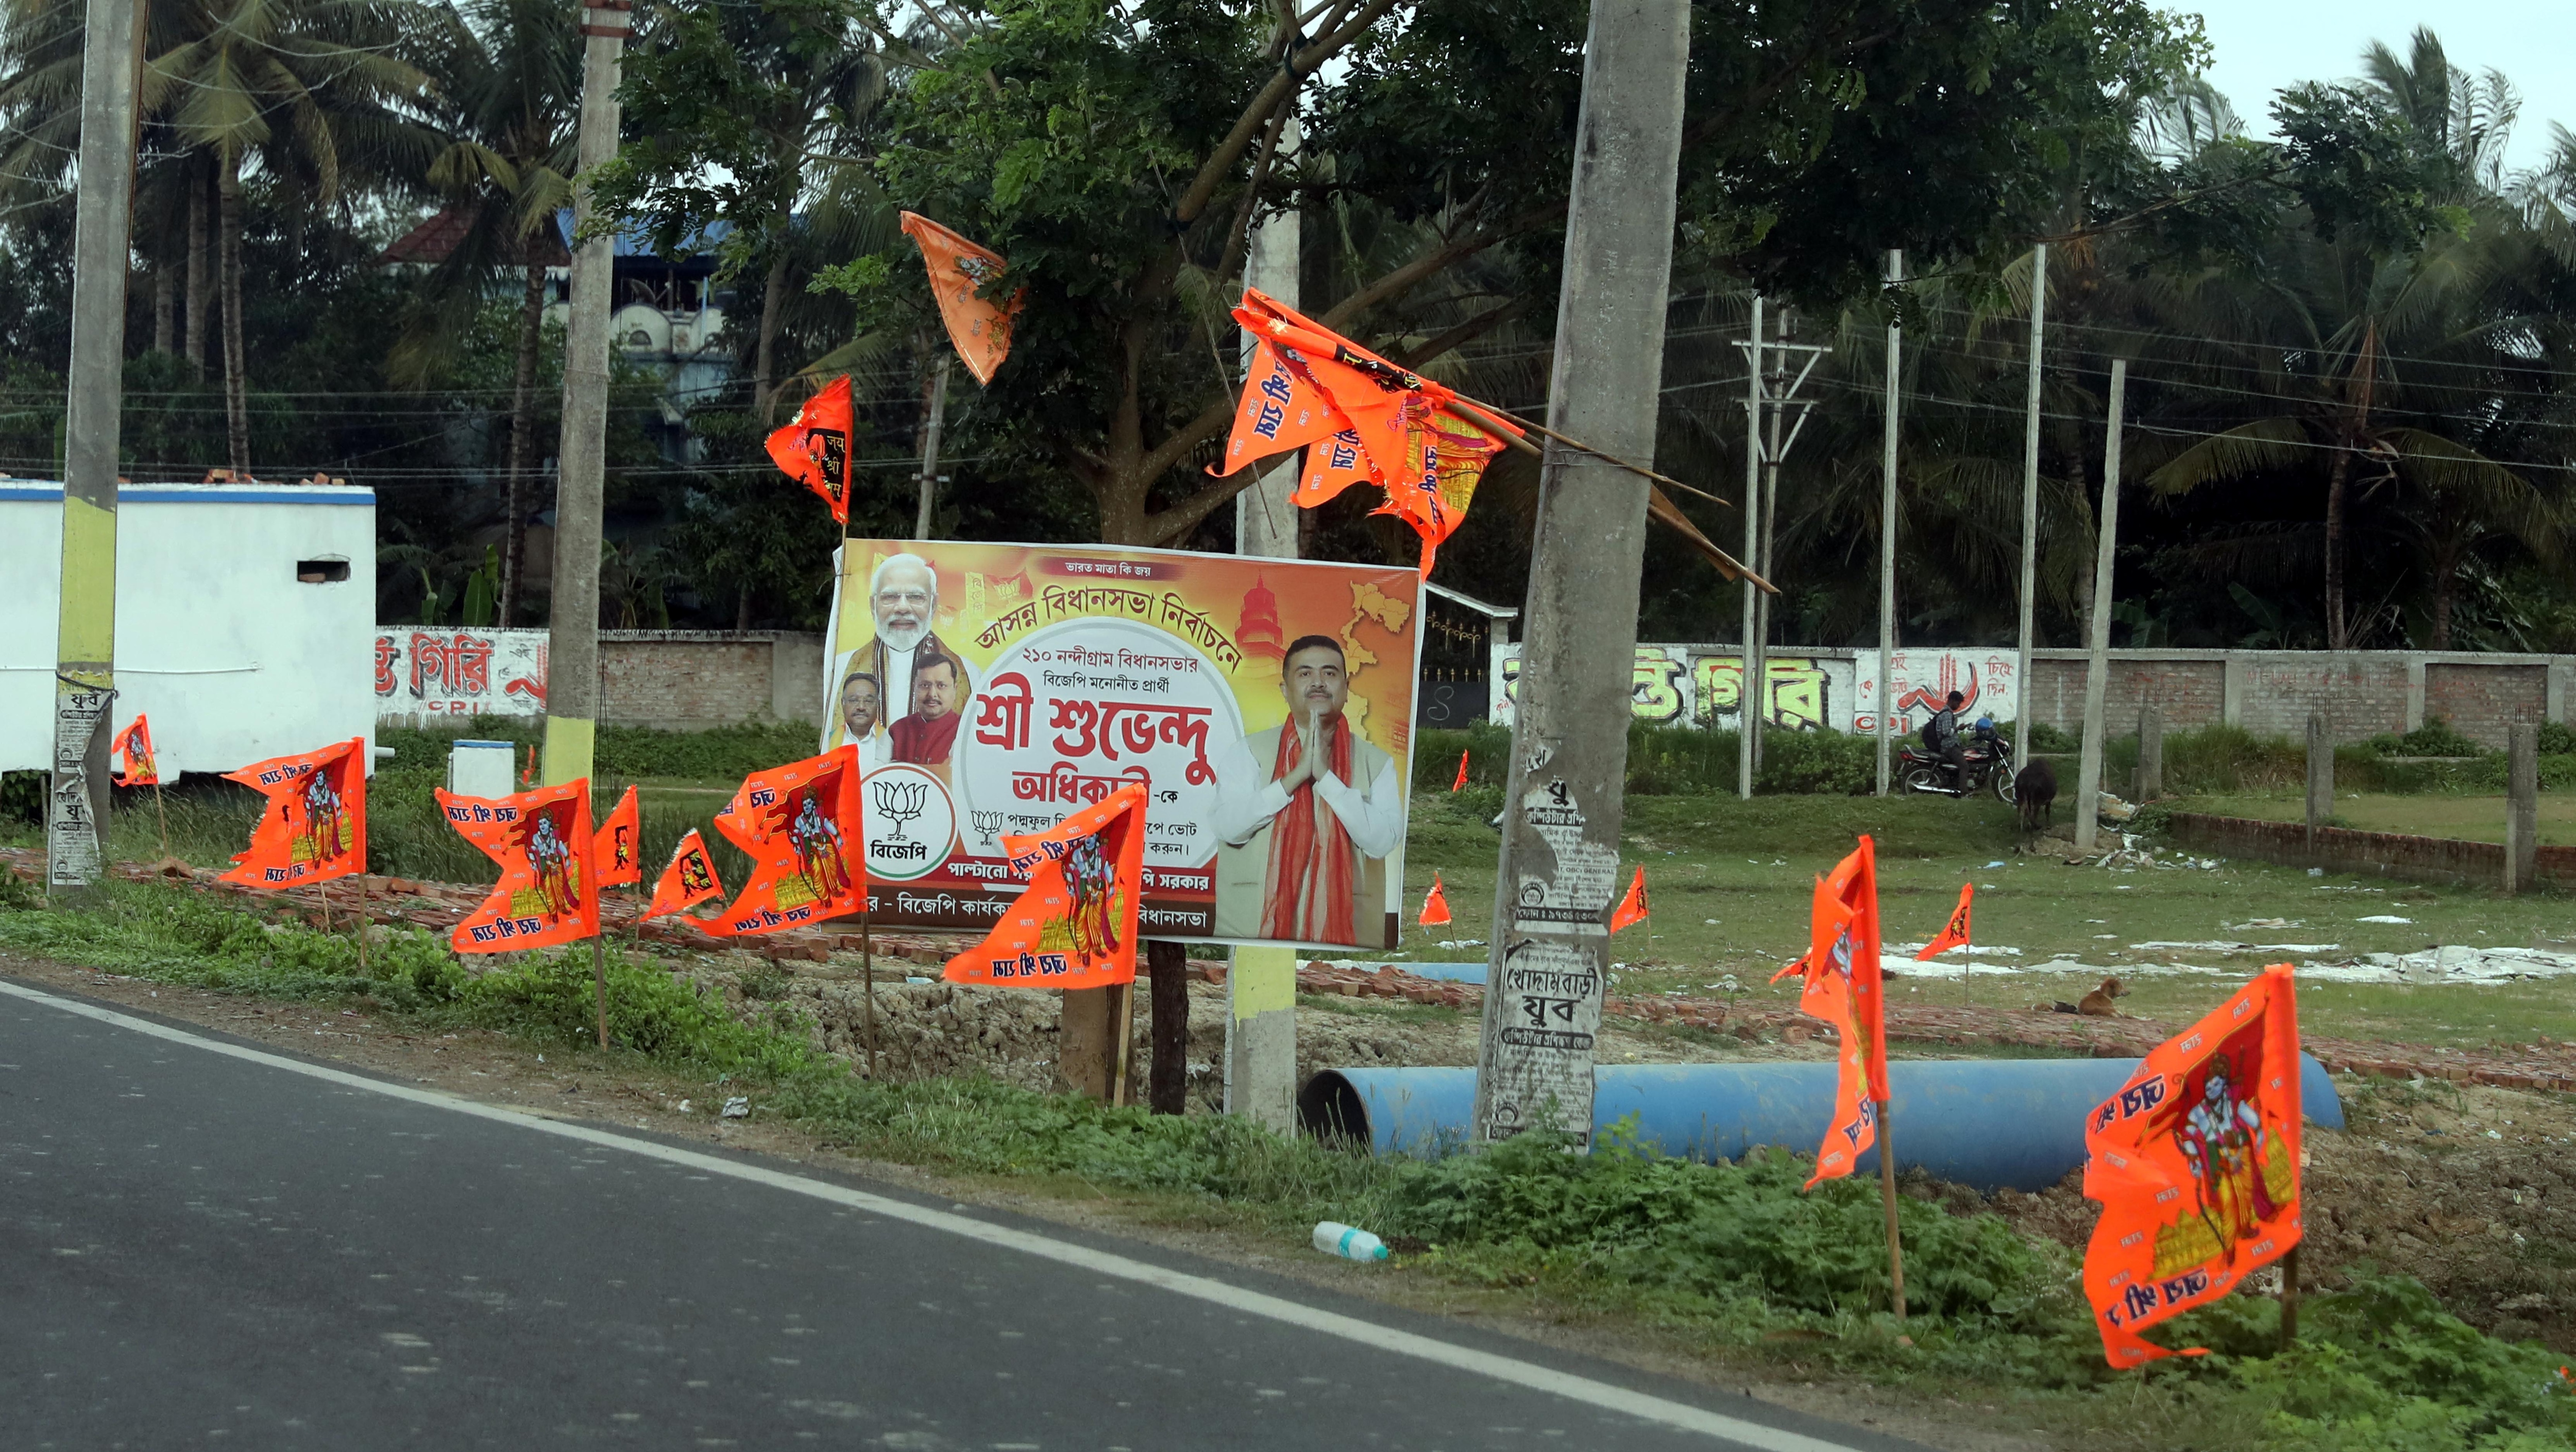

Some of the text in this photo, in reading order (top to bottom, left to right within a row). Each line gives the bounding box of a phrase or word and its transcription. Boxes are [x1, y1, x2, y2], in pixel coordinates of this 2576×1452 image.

[827, 435, 845, 452] जय
[827, 457, 840, 474] श्री
[1065, 562, 1150, 577] ভারত মাতা কি জয়
[974, 584, 1243, 674] আসন্ন বিধানসভা নির্বাচনে
[409, 633, 493, 696] গিরি
[1023, 645, 1198, 673] ২১০ নন্দীগ্রাম বিধানসভার
[1043, 670, 1170, 693] বিজেপি মনোনীত প্রার্থী
[976, 672, 1217, 787] শ্রী শুভেন্দু
[1012, 761, 1151, 808] অধিকাী
[1008, 814, 1050, 831] পদ্মফুল
[1168, 823, 1197, 836] ভোট
[870, 840, 928, 860] বিজেপি
[947, 861, 1008, 879] পাল্টানো
[1159, 875, 1209, 891] সরকার
[897, 891, 956, 915] বিজেপি
[960, 895, 1013, 916] কার্যক
[1522, 995, 1581, 1028] যুব
